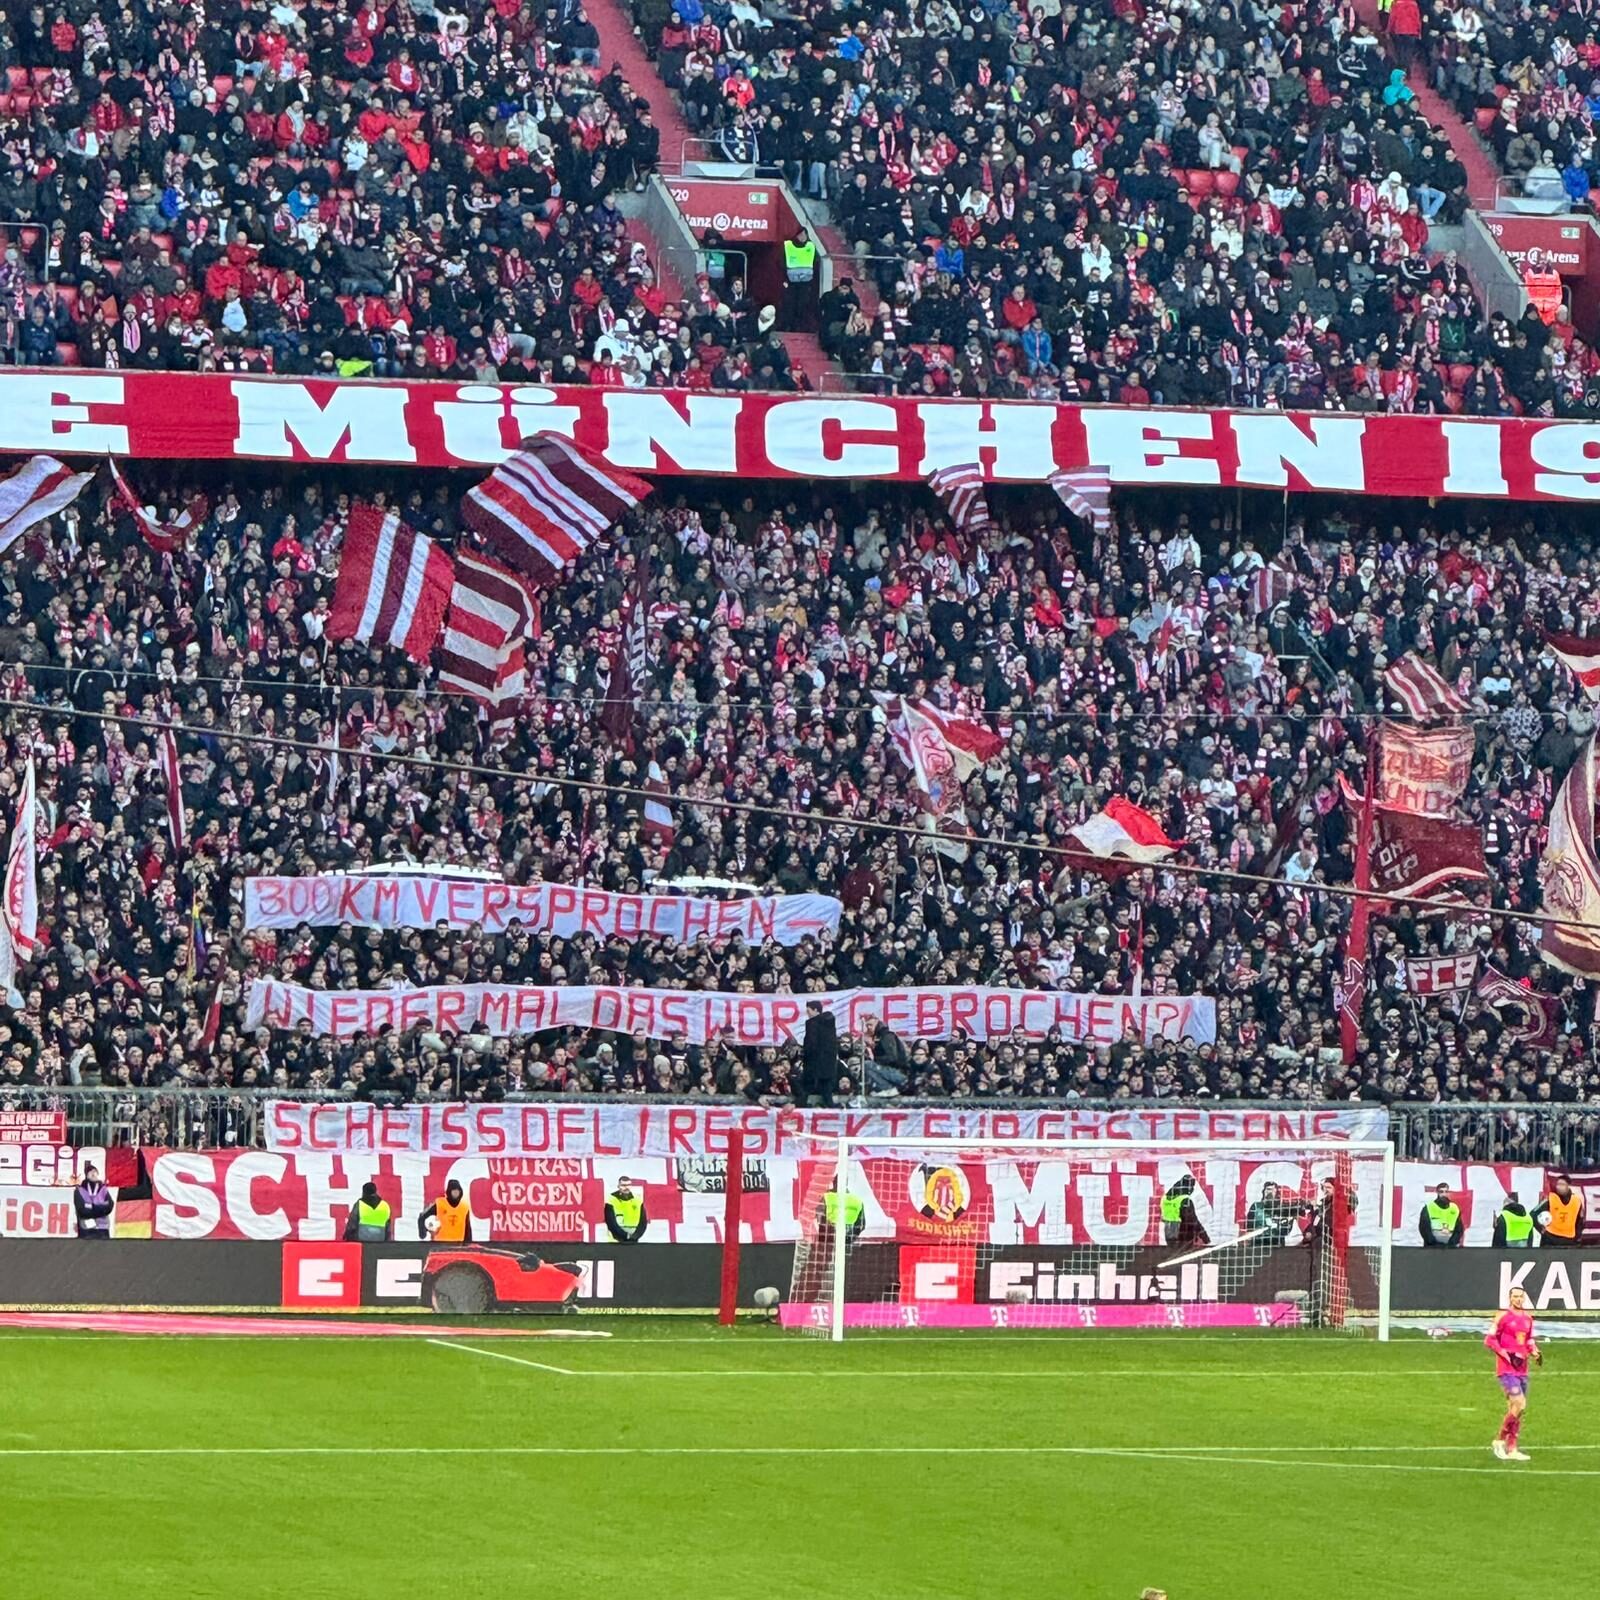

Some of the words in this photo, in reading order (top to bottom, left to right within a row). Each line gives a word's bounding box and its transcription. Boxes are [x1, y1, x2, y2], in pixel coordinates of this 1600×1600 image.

[731, 216, 769, 230] Arena
[1545, 249, 1580, 263] Arena
[413, 880, 777, 940] VERSPROCHEN
[1407, 955, 1475, 997] FCB
[592, 989, 688, 1036] DAS
[704, 998, 833, 1042] WOR
[274, 1103, 506, 1153] SCHEISS
[668, 1108, 909, 1156] RESPEKT
[491, 1181, 583, 1206] GEGEN
[491, 1209, 585, 1233] RASSISMUS
[989, 1262, 1219, 1300] Einhell
